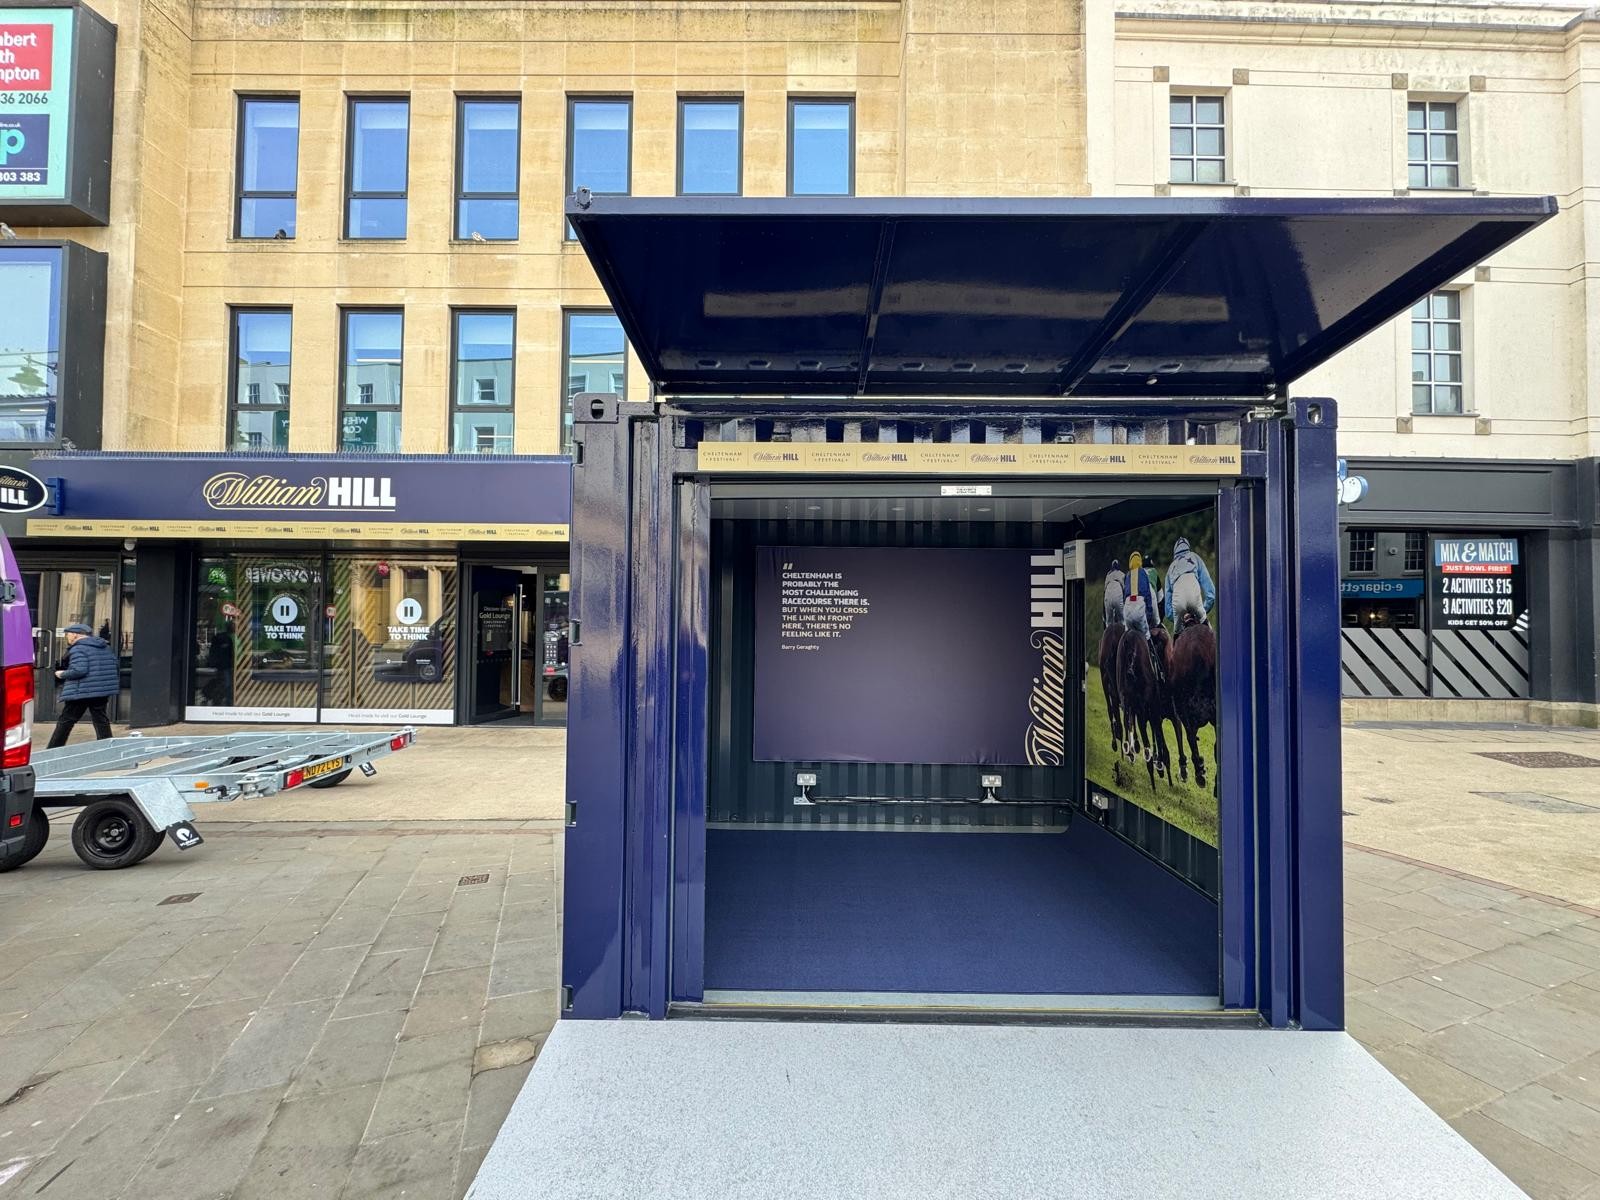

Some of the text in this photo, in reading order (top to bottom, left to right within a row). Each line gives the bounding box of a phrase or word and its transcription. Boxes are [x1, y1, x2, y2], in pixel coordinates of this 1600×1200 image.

[0, 32, 37, 47] bert
[18, 92, 48, 104] 2066
[20, 172, 40, 182] 383
[202, 472, 396, 507] William HILL
[1441, 542, 1513, 562] MIX & MATCH
[1031, 549, 1064, 628] HILL
[1442, 578, 1512, 594] 2 ACTIVITIES £15
[1442, 598, 1513, 615] 3 ACTIVITIES £20
[1025, 629, 1064, 766] William
